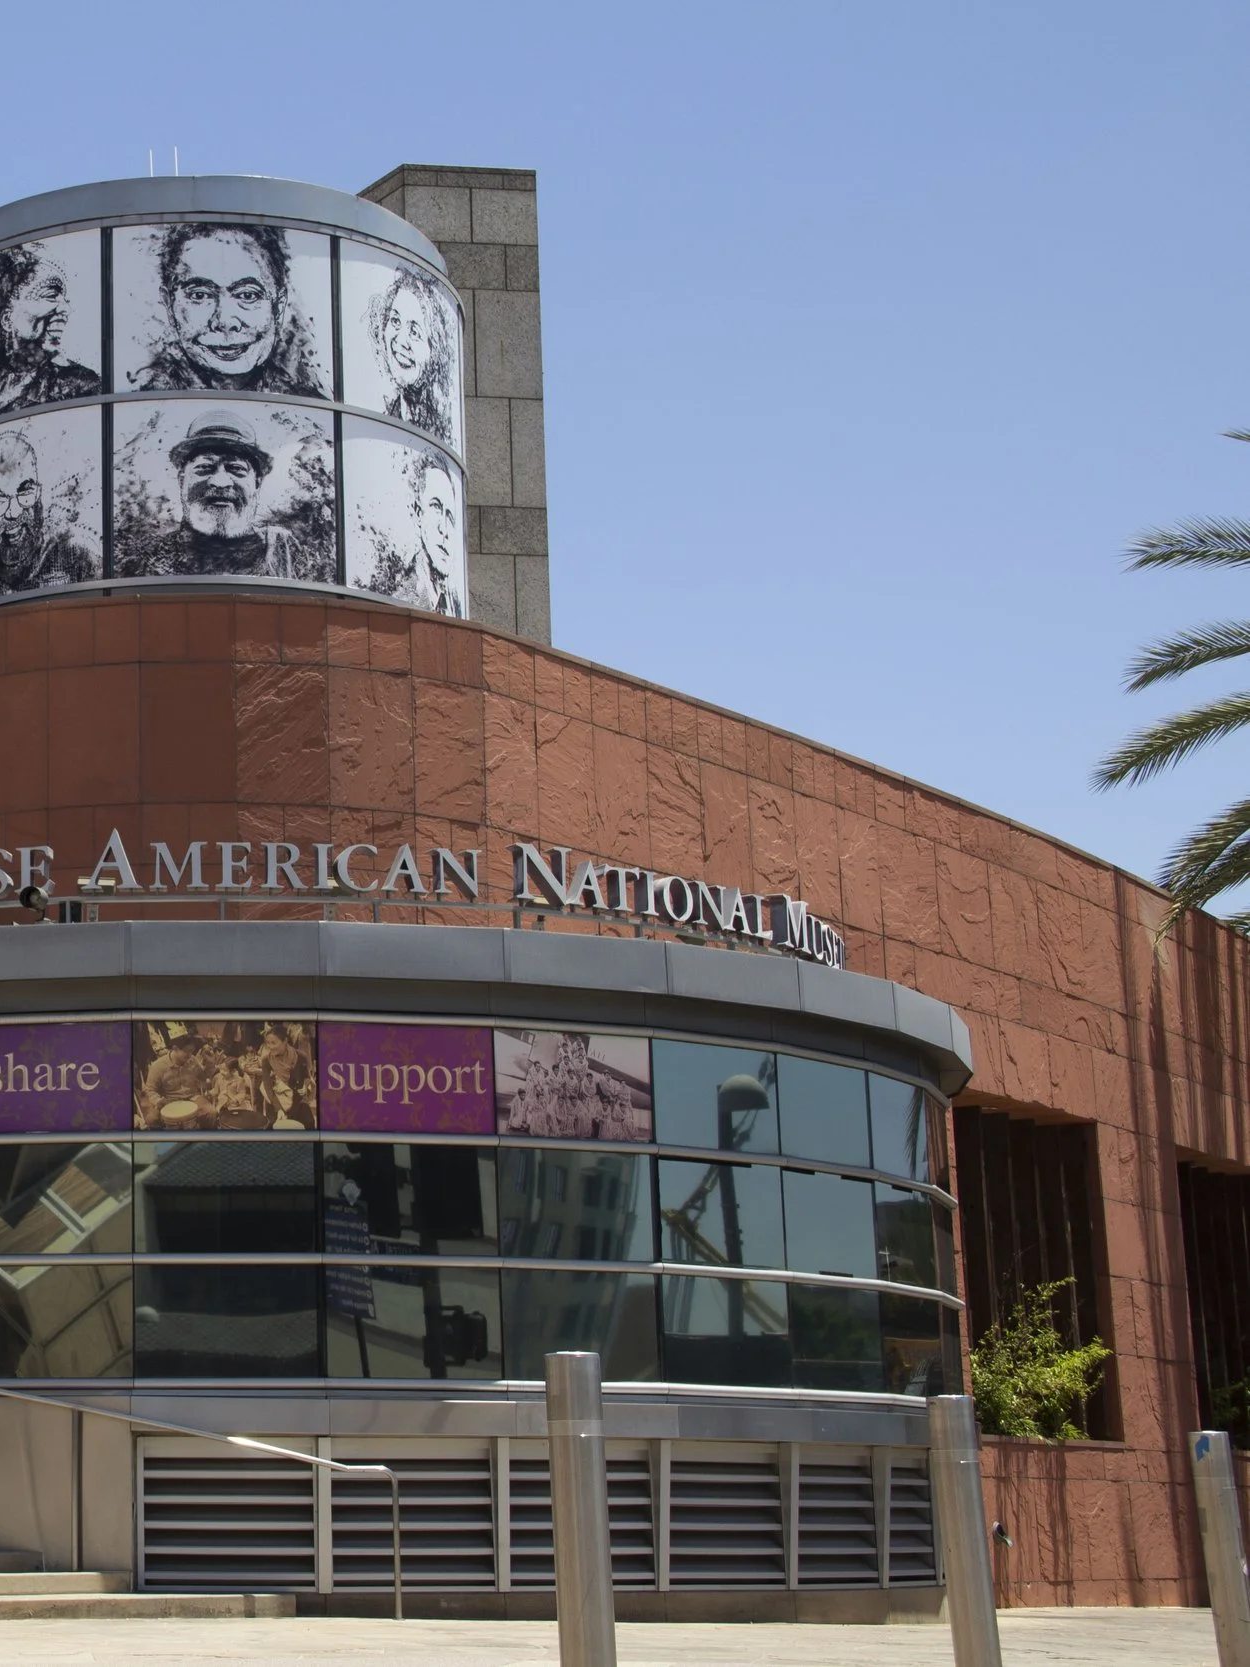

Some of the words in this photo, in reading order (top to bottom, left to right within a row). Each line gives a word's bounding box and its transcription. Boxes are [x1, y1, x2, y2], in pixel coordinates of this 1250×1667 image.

[81, 827, 482, 898] AMERICAN
[505, 843, 773, 941] NATIONAL
[765, 893, 845, 970] MUSE
[327, 1059, 487, 1104] support
